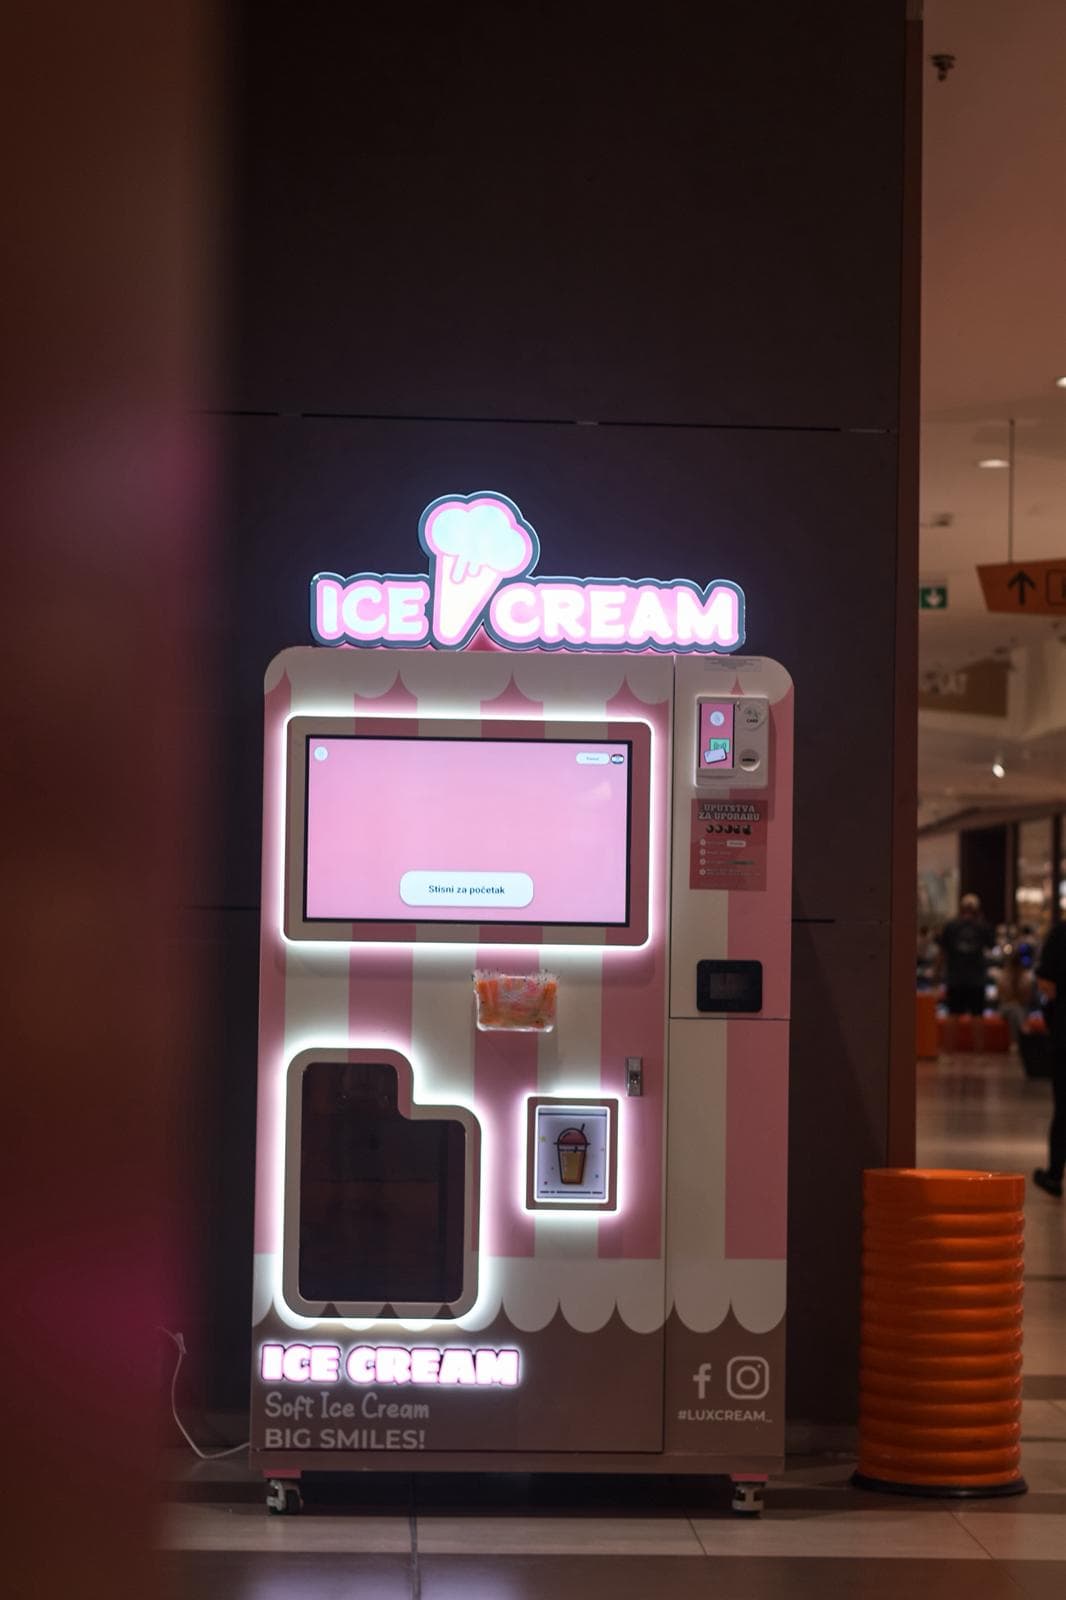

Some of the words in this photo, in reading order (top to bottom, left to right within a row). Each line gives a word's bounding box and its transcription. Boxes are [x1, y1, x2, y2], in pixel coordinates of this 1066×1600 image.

[319, 581, 429, 639] ICE
[491, 584, 740, 645] CREAM
[428, 885, 454, 894] Stisni
[261, 1344, 341, 1382] ICE
[346, 1345, 520, 1385] CREAM
[264, 1391, 314, 1421] Soft
[320, 1392, 355, 1419] Ice
[361, 1392, 430, 1419] Cream
[264, 1428, 312, 1449] BIG
[319, 1429, 426, 1449] SMILES!
